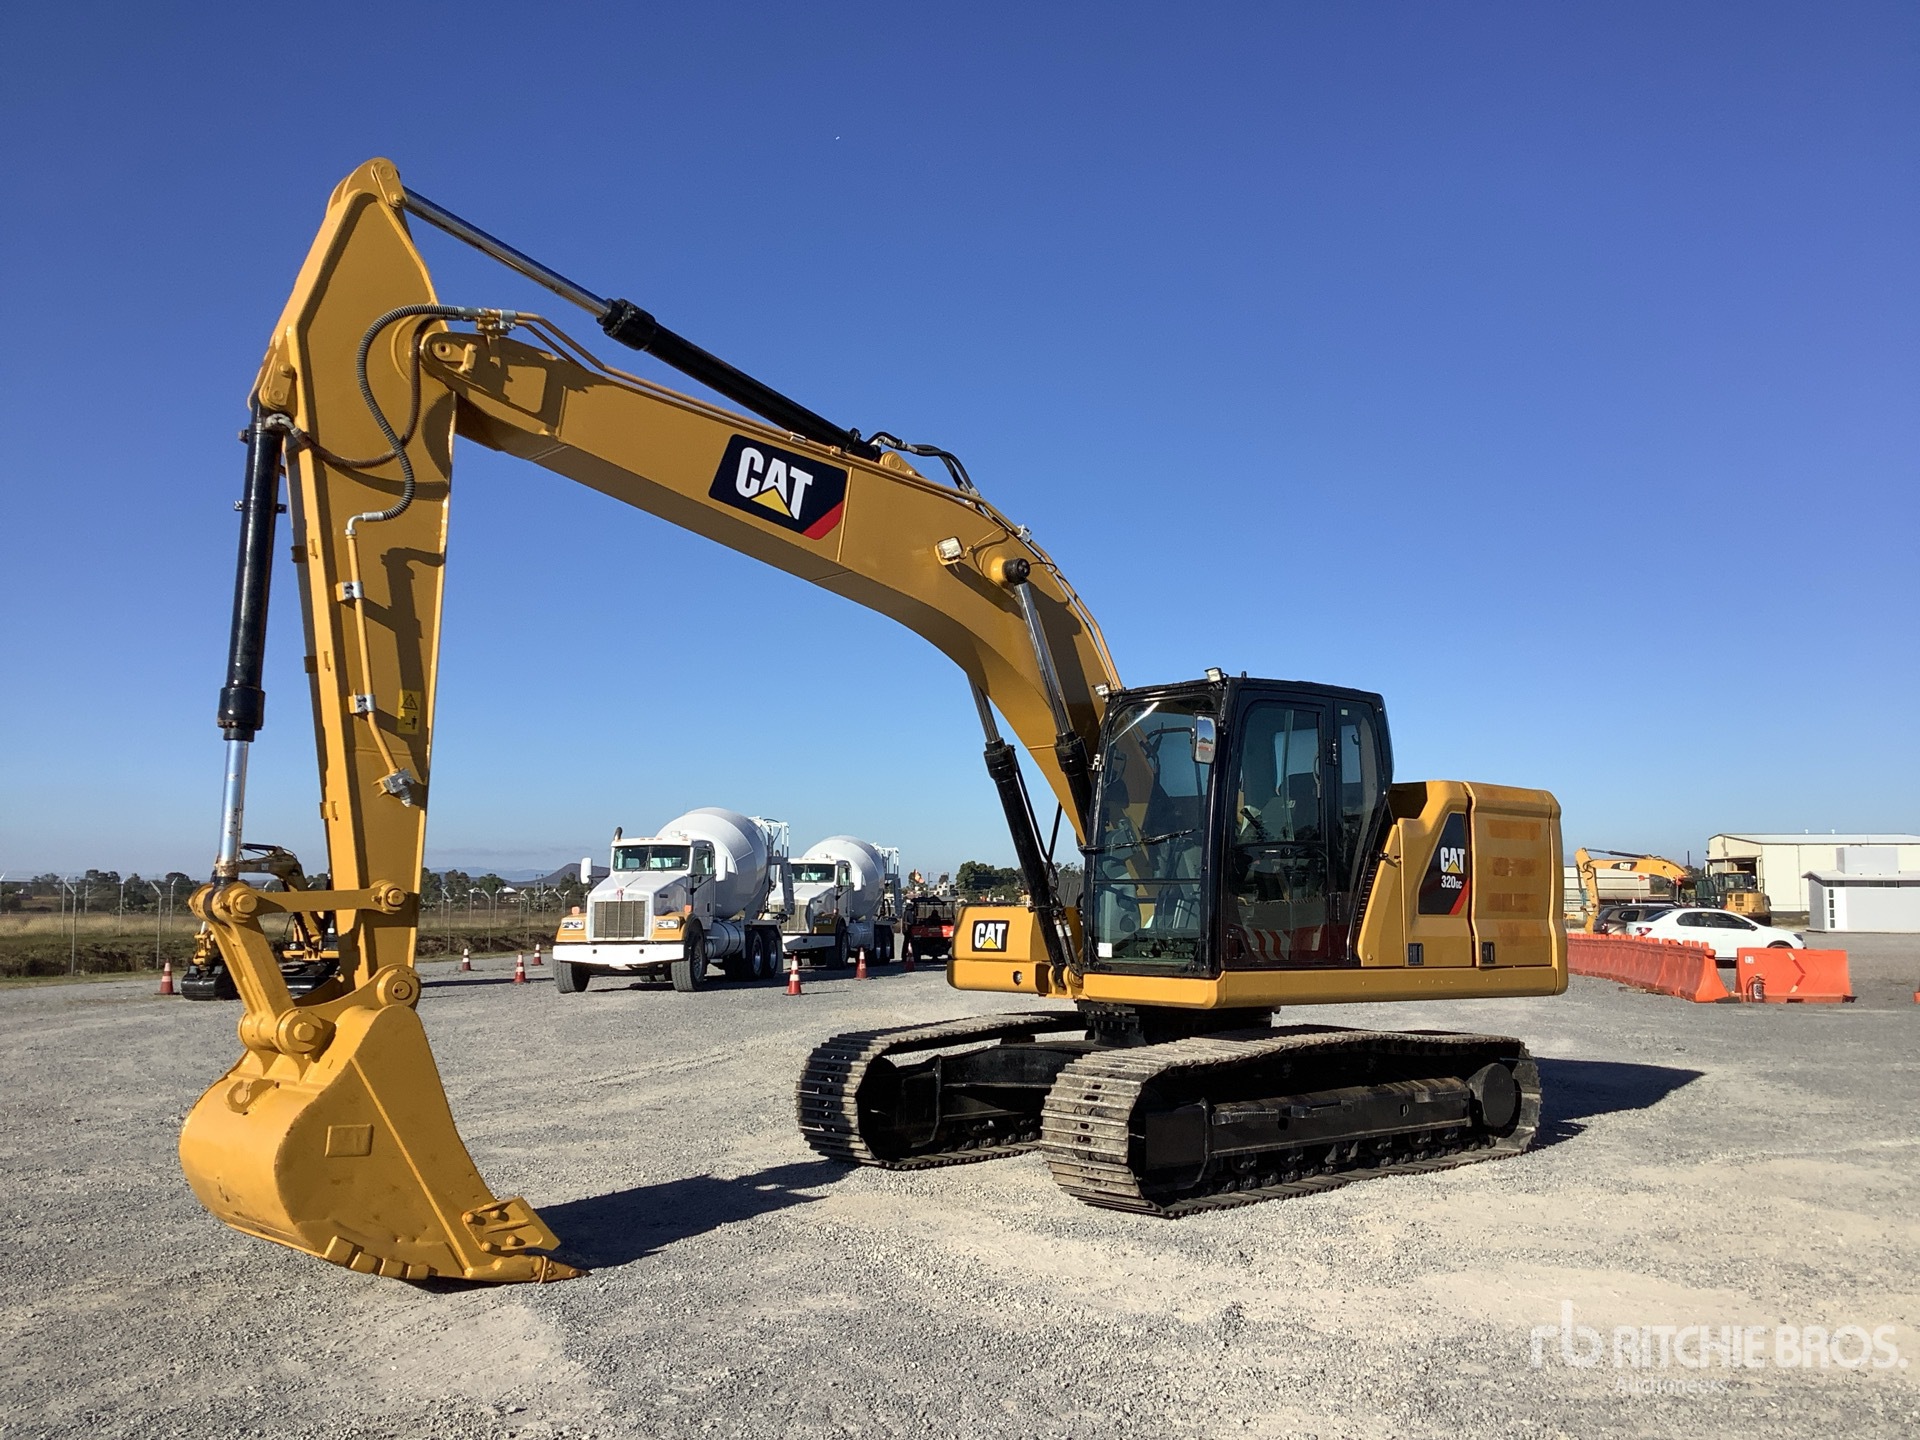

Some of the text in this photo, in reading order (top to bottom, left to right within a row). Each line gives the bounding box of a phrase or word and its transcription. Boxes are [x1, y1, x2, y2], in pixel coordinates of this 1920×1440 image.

[735, 447, 814, 521] CAT
[1440, 846, 1465, 873] CAT
[1619, 862, 1631, 871] CAT
[974, 923, 1007, 949] CAT
